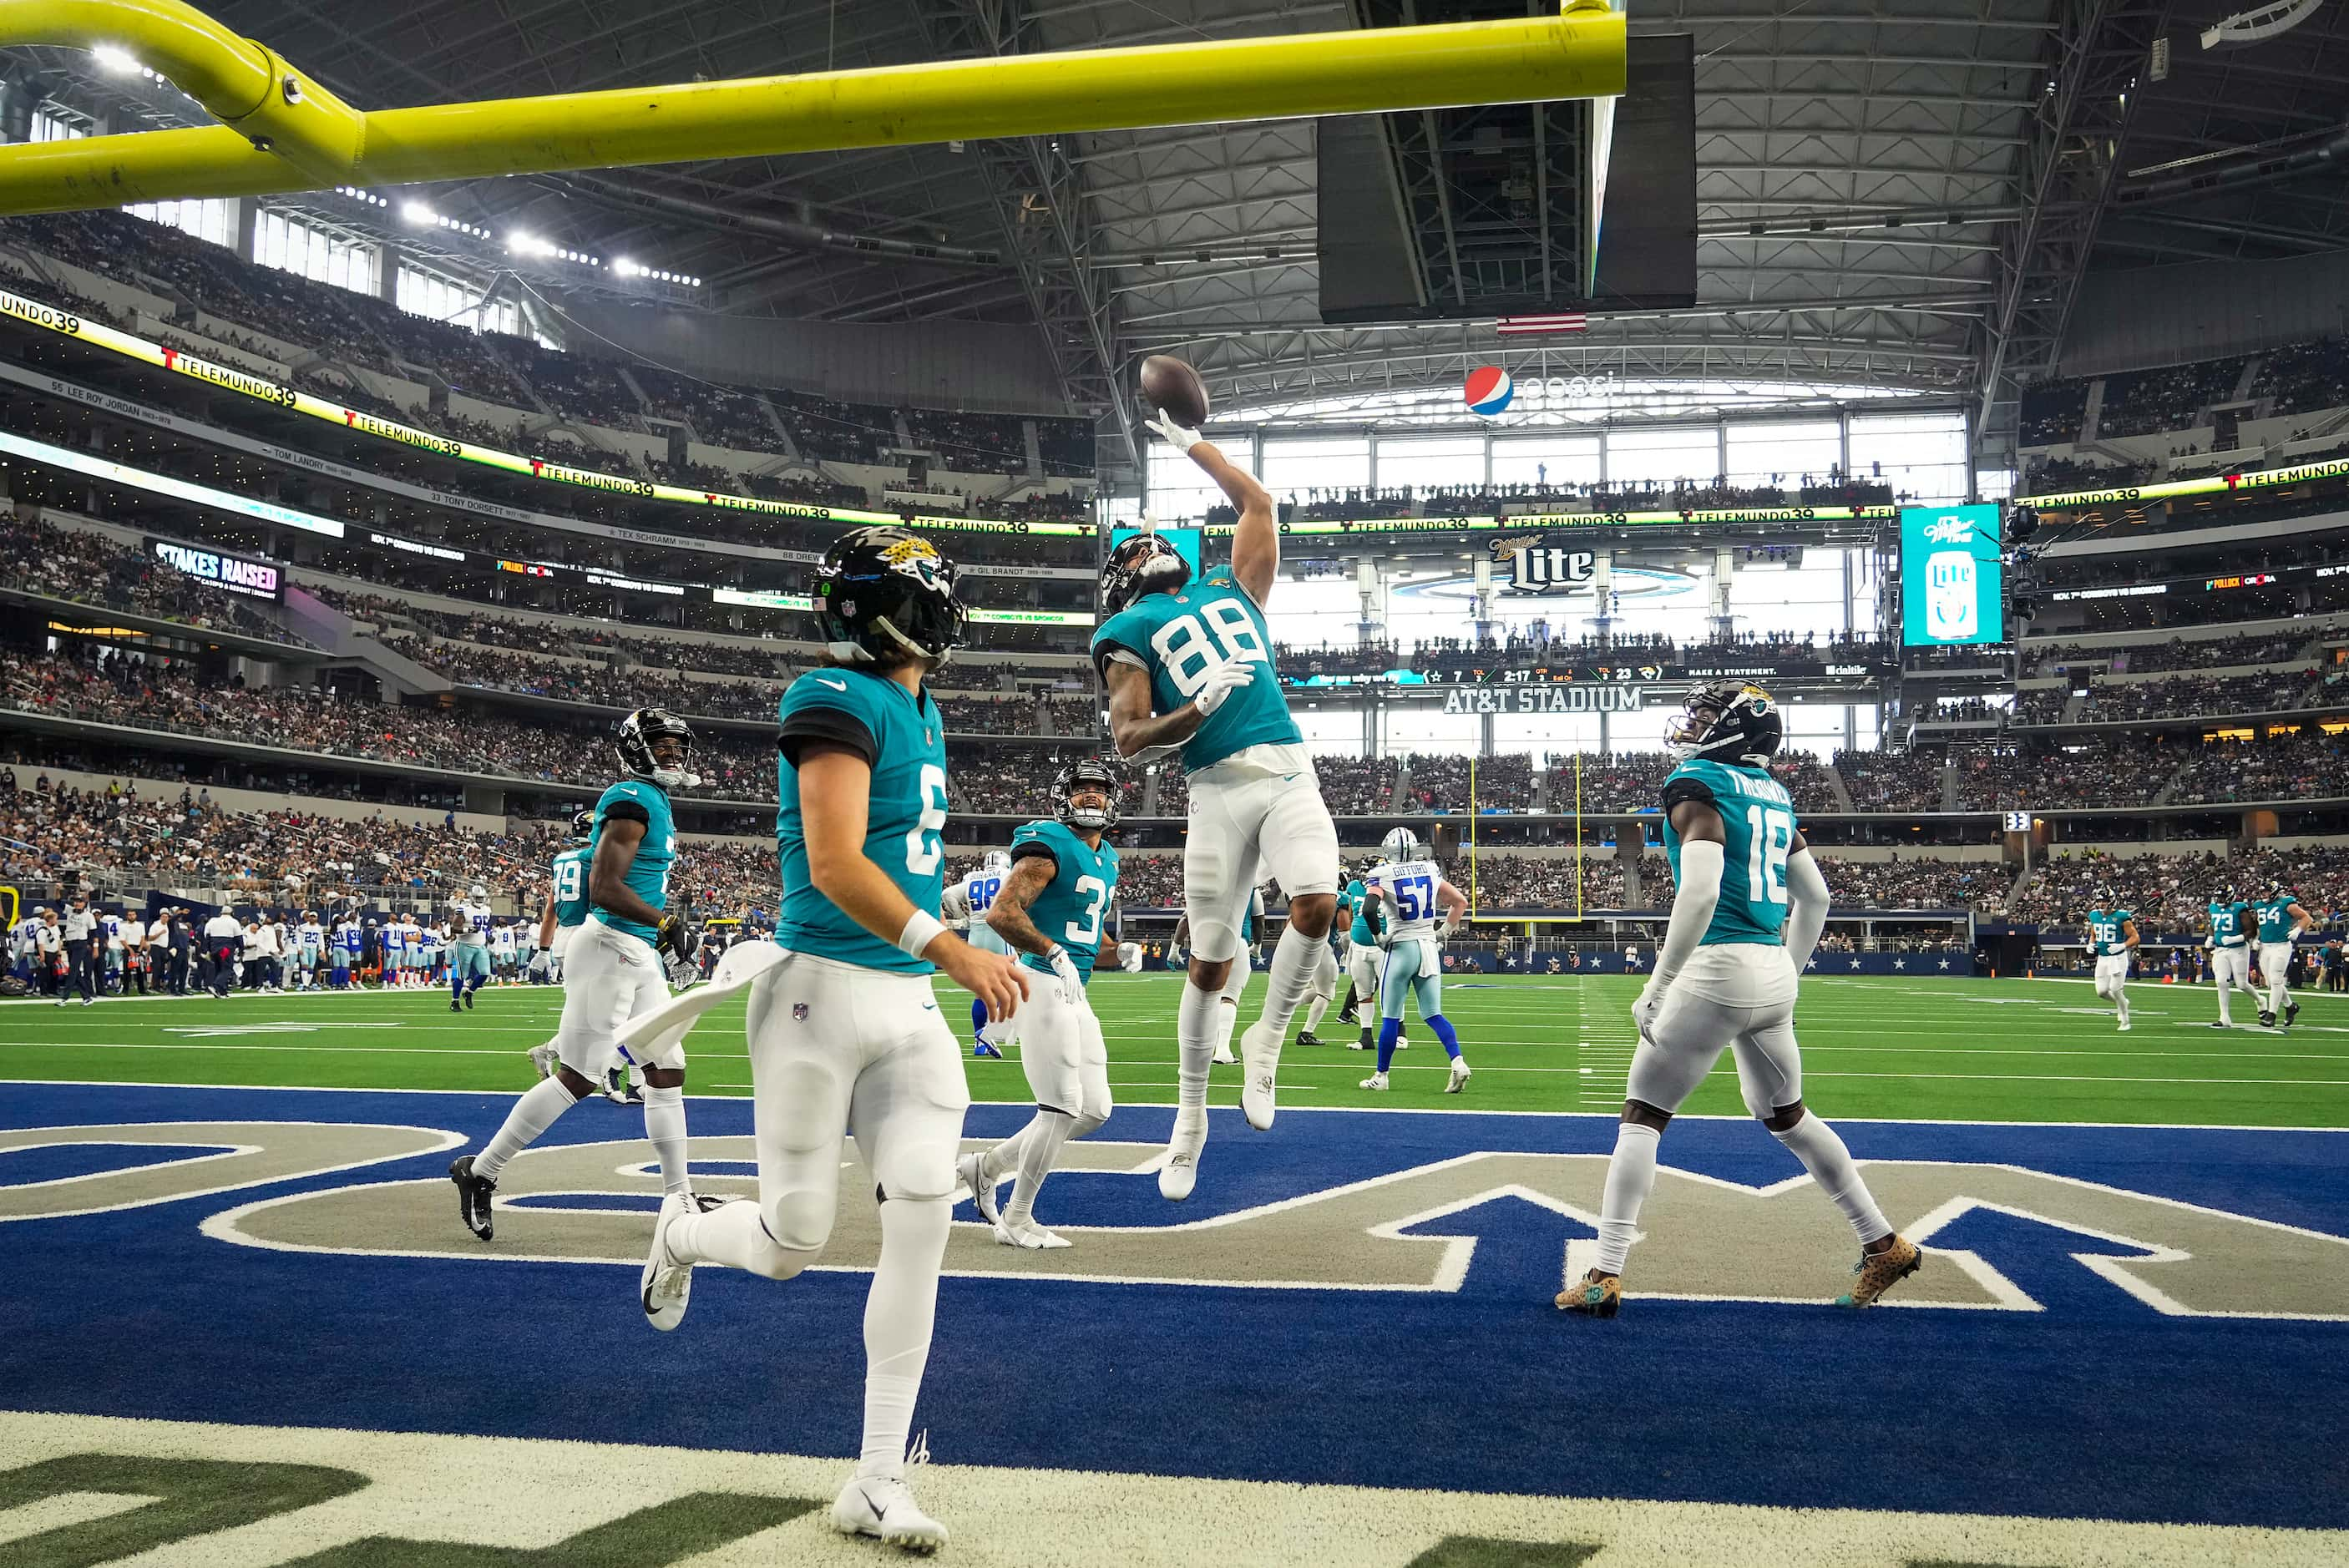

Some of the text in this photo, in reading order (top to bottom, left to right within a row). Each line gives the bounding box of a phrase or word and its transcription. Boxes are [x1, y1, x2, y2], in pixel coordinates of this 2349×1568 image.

[180, 357, 296, 407] TELEMUNDO39
[1523, 371, 1614, 407] pepsi
[51, 382, 63, 392] 55
[68, 387, 84, 399] LEE
[86, 392, 104, 404] ROY
[105, 399, 140, 417] JORDAN
[361, 417, 462, 456] TELEMUNDO39
[274, 448, 291, 460] TOM
[294, 455, 324, 470] LANDRY
[545, 468, 655, 497] TELEMUNDO39
[431, 493, 440, 502] 33
[445, 495, 465, 507] TONY
[468, 498, 504, 515] DORSETT
[721, 498, 830, 519] TELEMUNDO39
[918, 518, 1029, 534] TELEMUNDO39
[1357, 518, 1469, 532] TELEMUNDO39
[1512, 513, 1627, 528] TELEMUNDO39
[1697, 508, 1814, 523] TELEMUNDO39
[618, 529, 633, 539] TEX
[635, 534, 676, 544] SCHRAMM
[782, 551, 820, 561] 88 DREW
[1489, 534, 1544, 561] Miller
[156, 543, 277, 591] STAKES RAISED
[1510, 548, 1592, 592] Lite
[1933, 564, 1969, 588] Lite
[1152, 598, 1268, 697] 88
[1352, 674, 1370, 684] why
[1454, 670, 1462, 681] 7
[1504, 670, 1531, 681] 2:17
[1617, 669, 1631, 680] 23
[1444, 686, 1643, 714] AT&T STADIUM
[906, 763, 947, 877] 6
[2007, 812, 2028, 829] 33
[1747, 805, 1793, 904] 18
[1393, 864, 1428, 877] GIFFORD
[1393, 875, 1434, 921] 57
[2211, 913, 2233, 931] 73
[305, 932, 319, 943] 23
[393, 929, 400, 940] 11
